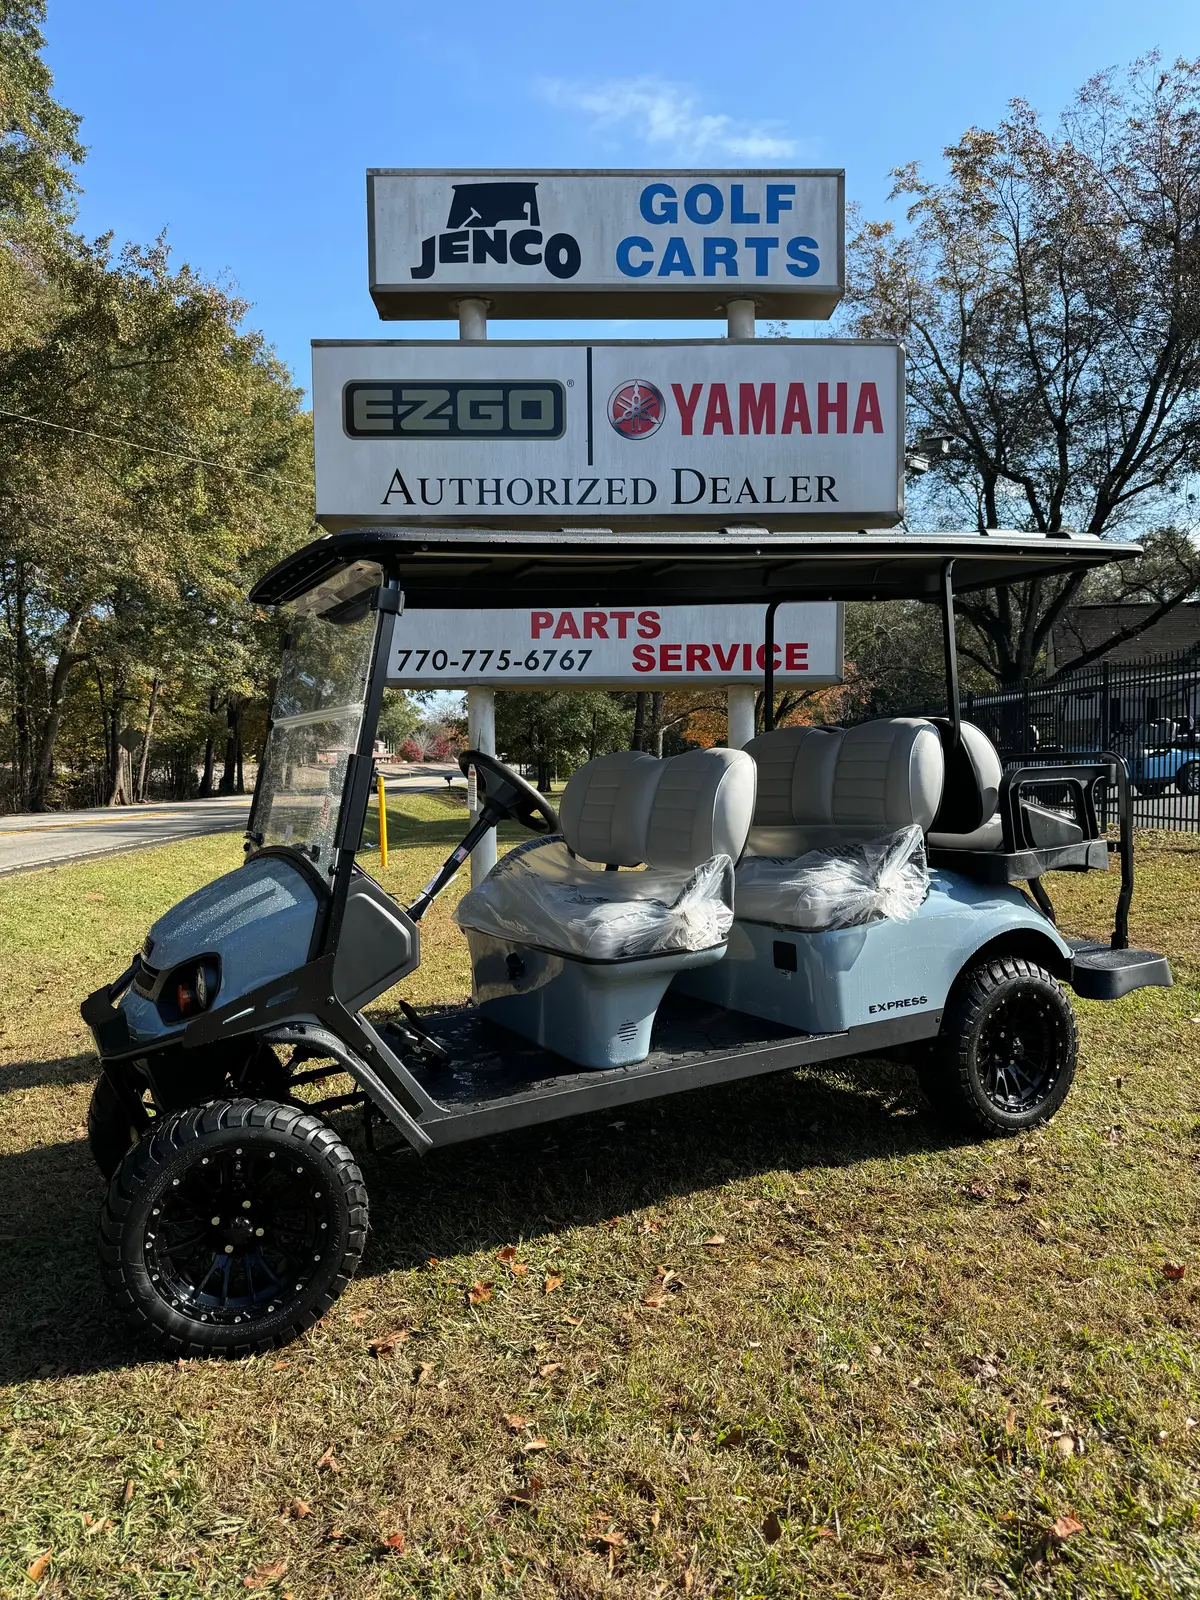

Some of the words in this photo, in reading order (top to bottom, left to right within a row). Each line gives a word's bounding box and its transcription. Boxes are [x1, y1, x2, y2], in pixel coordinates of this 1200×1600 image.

[639, 183, 797, 225] GOLF
[410, 229, 582, 280] JENCO
[615, 235, 821, 279] CARTS
[671, 382, 884, 435] YAMAHA
[380, 468, 657, 506] AUTHORIZED
[671, 468, 840, 505] DEALER
[530, 611, 662, 639] PARTS
[397, 649, 593, 672] 770-775-6767
[631, 643, 809, 672] SERVICE
[868, 995, 928, 1014] EXPRESS
